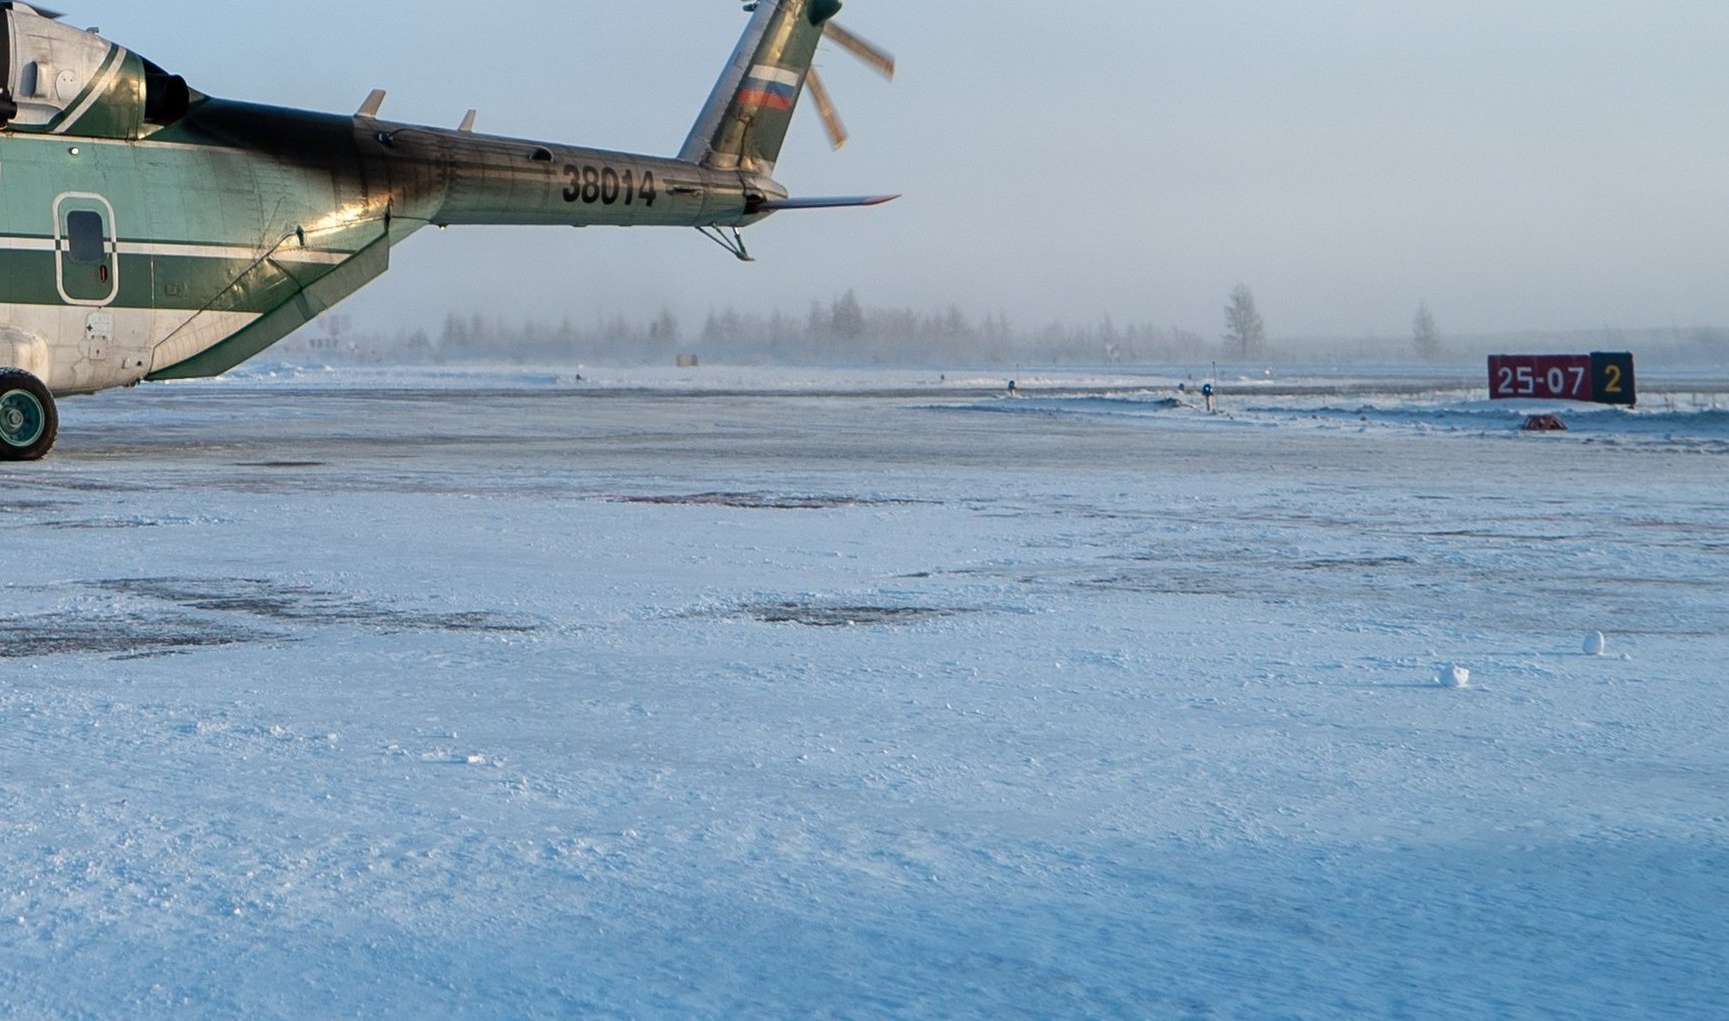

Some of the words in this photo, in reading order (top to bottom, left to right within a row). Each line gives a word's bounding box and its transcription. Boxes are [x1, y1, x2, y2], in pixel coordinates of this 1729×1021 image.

[562, 164, 657, 207] 38014
[1497, 366, 1585, 395] 25-07
[1604, 364, 1622, 393] 2
